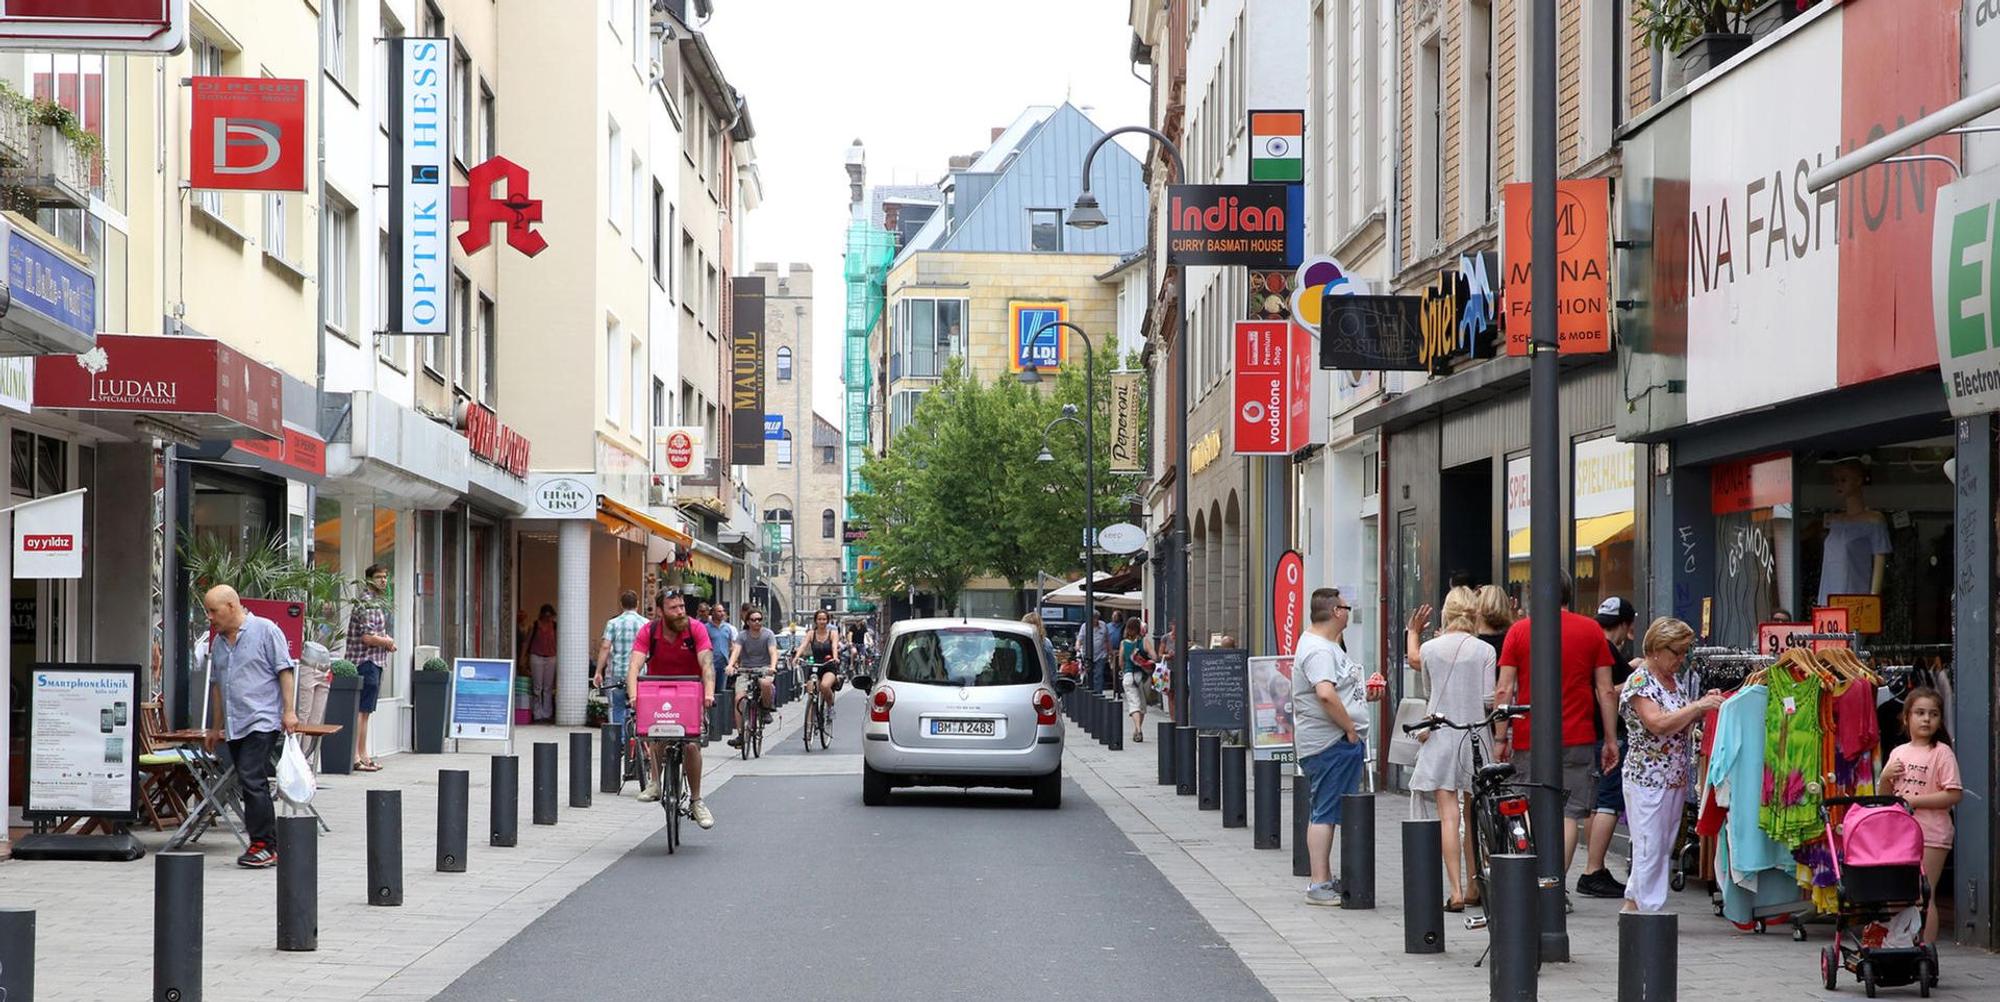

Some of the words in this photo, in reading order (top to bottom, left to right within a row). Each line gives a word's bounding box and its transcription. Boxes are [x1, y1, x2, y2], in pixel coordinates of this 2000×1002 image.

[412, 42, 437, 148] HESS
[1171, 196, 1285, 232] Indian
[1172, 239, 1204, 252] CURRY
[1207, 239, 1249, 252] BASMATI
[1250, 239, 1285, 252] HOUSE
[412, 199, 437, 325] OPTIK
[1511, 258, 1601, 285] MNA
[1418, 268, 1456, 376] Spiel
[1559, 333, 1567, 341] &
[1568, 330, 1601, 341] MODE
[1021, 346, 1057, 359] ALDI
[1263, 330, 1272, 366] Premium
[1273, 345, 1282, 366] Shop
[734, 331, 758, 410] MAUEL
[1953, 361, 2000, 398] Electron
[99, 379, 177, 398] LUDARI
[1112, 385, 1130, 461] Peperoni
[1267, 379, 1280, 445] vodafone
[27, 539, 40, 550] ay
[653, 711, 680, 719] foodora
[937, 721, 951, 732] BM
[958, 722, 965, 733] A
[966, 722, 993, 734] 2483
